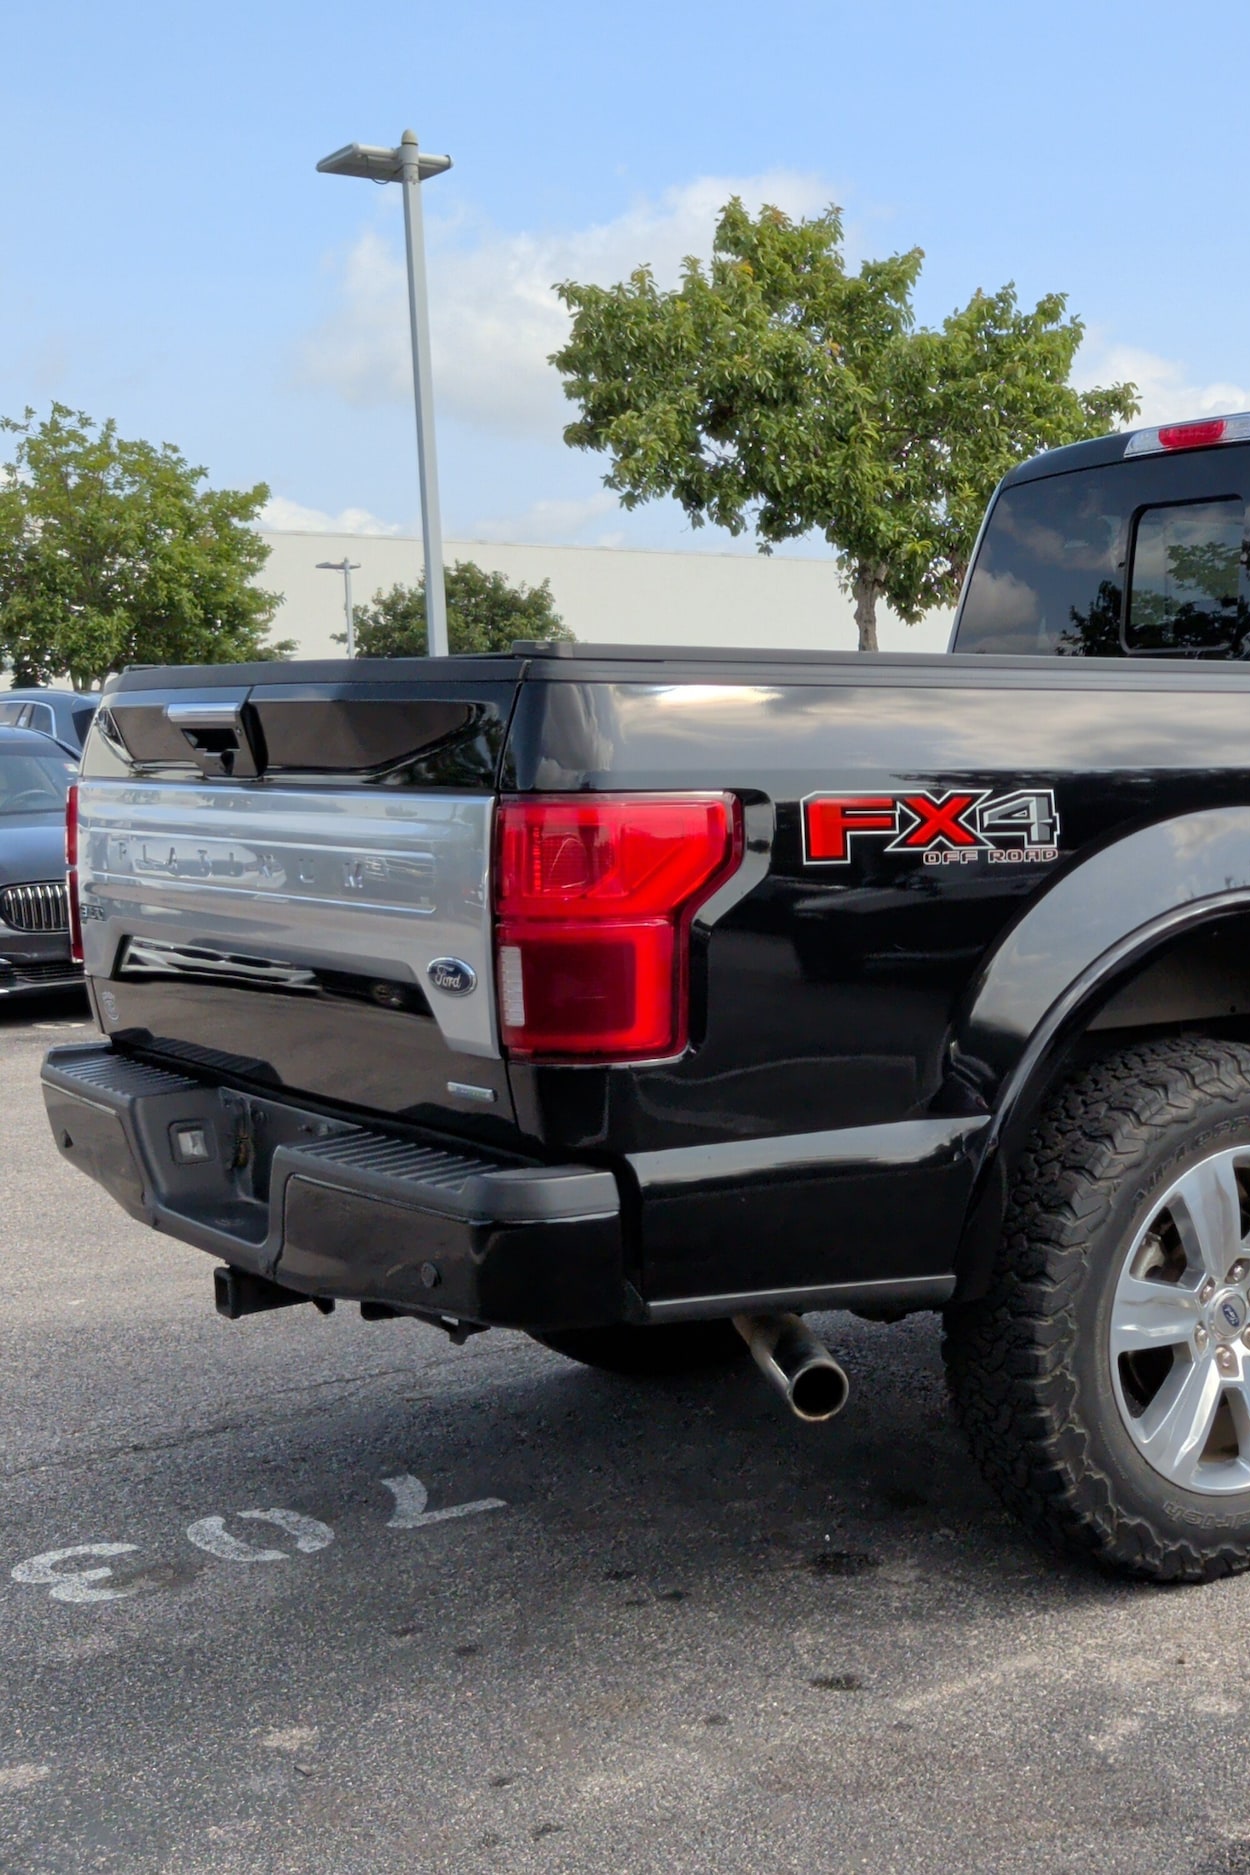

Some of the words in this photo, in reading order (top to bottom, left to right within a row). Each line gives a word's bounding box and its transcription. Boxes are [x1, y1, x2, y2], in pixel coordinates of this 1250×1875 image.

[801, 789, 1060, 865] FX4
[117, 841, 365, 889] PLATINUM
[923, 849, 978, 866] OFF
[988, 847, 1058, 864] ROAD
[434, 964, 463, 990] Ford
